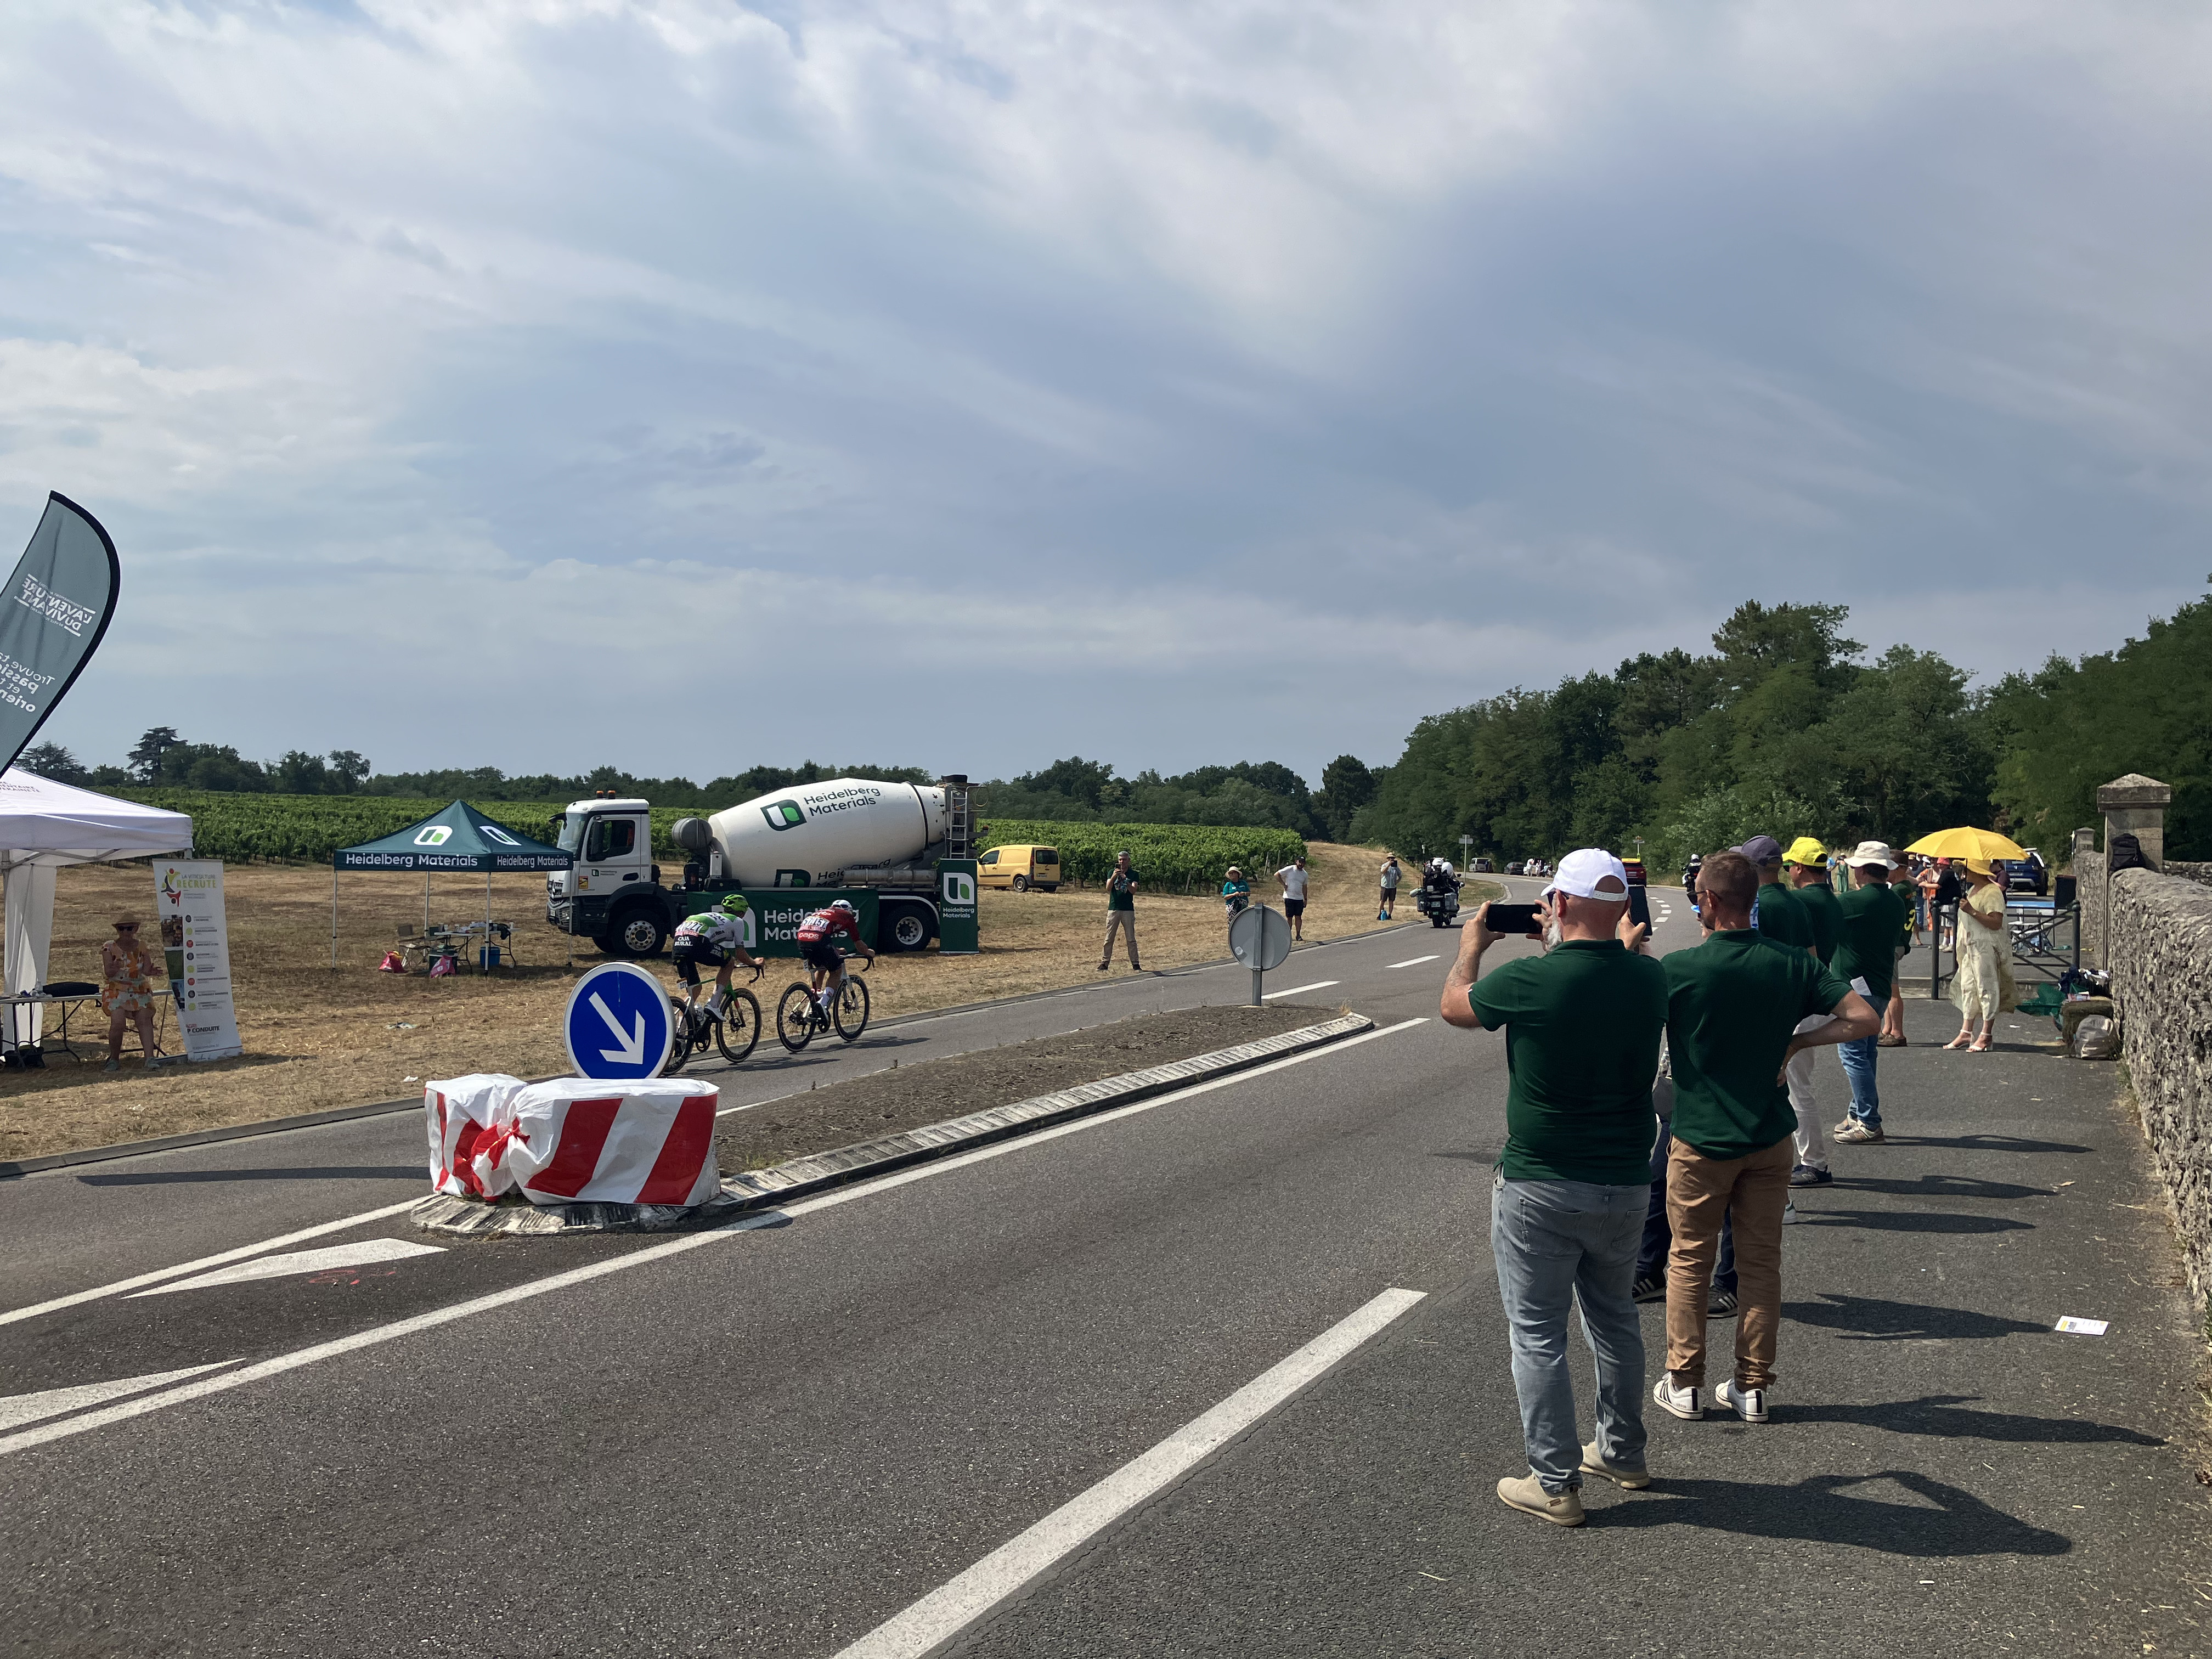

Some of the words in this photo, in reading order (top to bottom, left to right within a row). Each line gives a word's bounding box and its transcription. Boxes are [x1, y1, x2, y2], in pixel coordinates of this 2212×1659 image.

[803, 788, 881, 805] Heidelberg
[809, 795, 877, 816] Materials
[346, 853, 414, 868] Heidelberg
[419, 854, 478, 866] Materials
[496, 855, 535, 868] Heidelberg
[537, 855, 568, 866] Materials
[177, 879, 217, 888] RECRUTE
